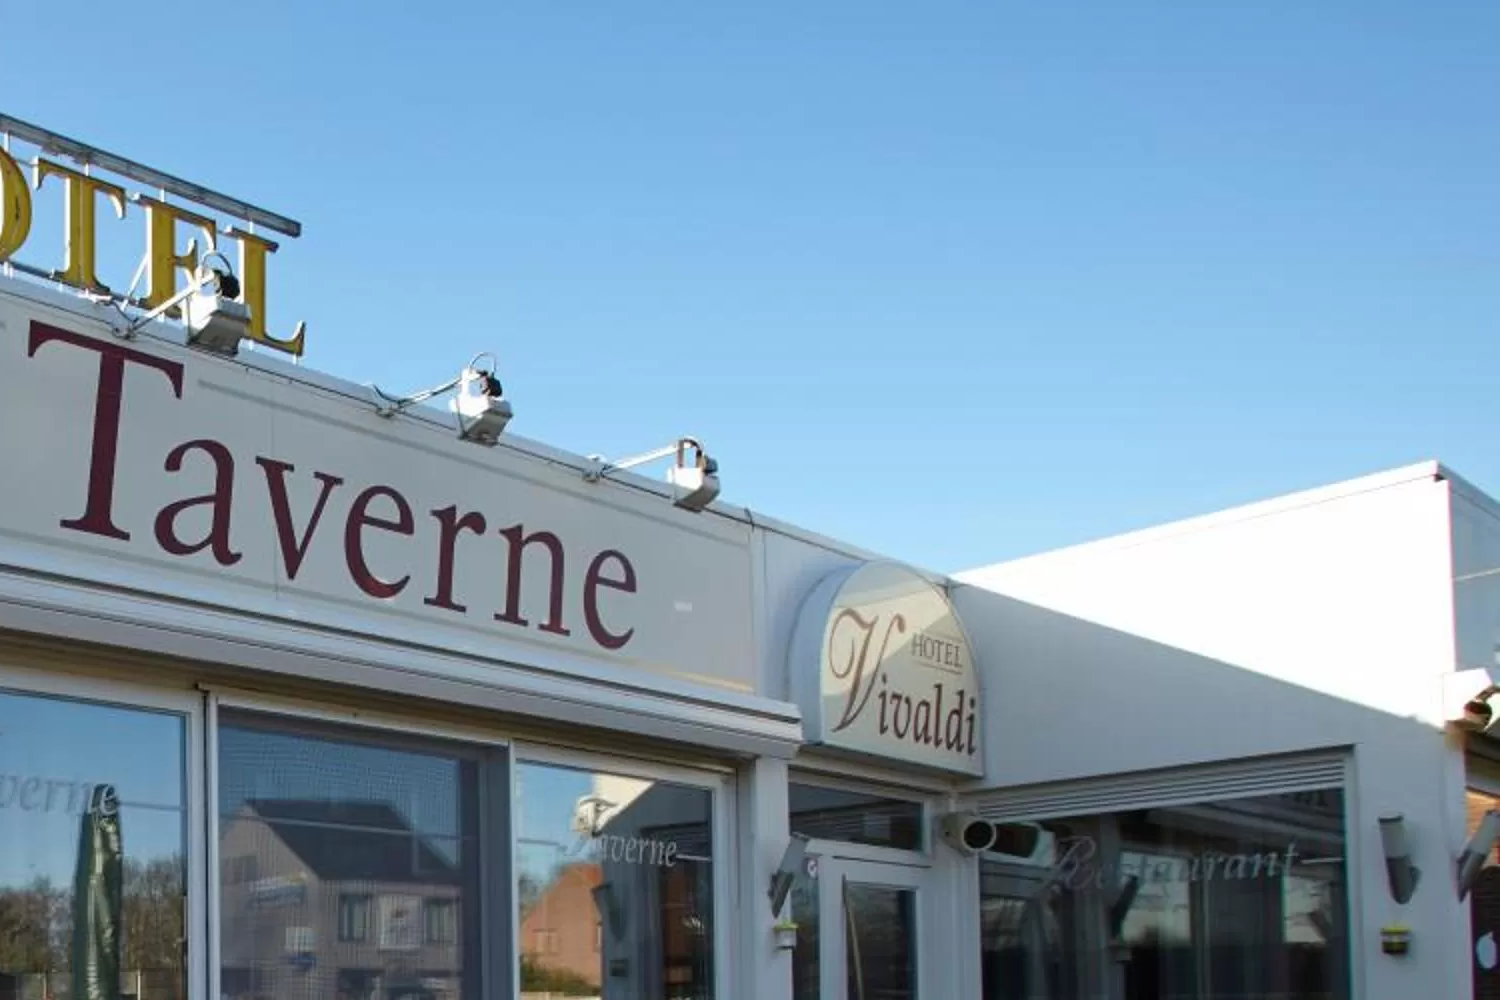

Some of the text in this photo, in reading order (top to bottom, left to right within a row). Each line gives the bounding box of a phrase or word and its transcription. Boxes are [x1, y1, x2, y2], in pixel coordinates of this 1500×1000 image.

[27, 319, 637, 649] Taverne
[827, 607, 977, 756] Vivaldi
[911, 631, 963, 669] HOTEL
